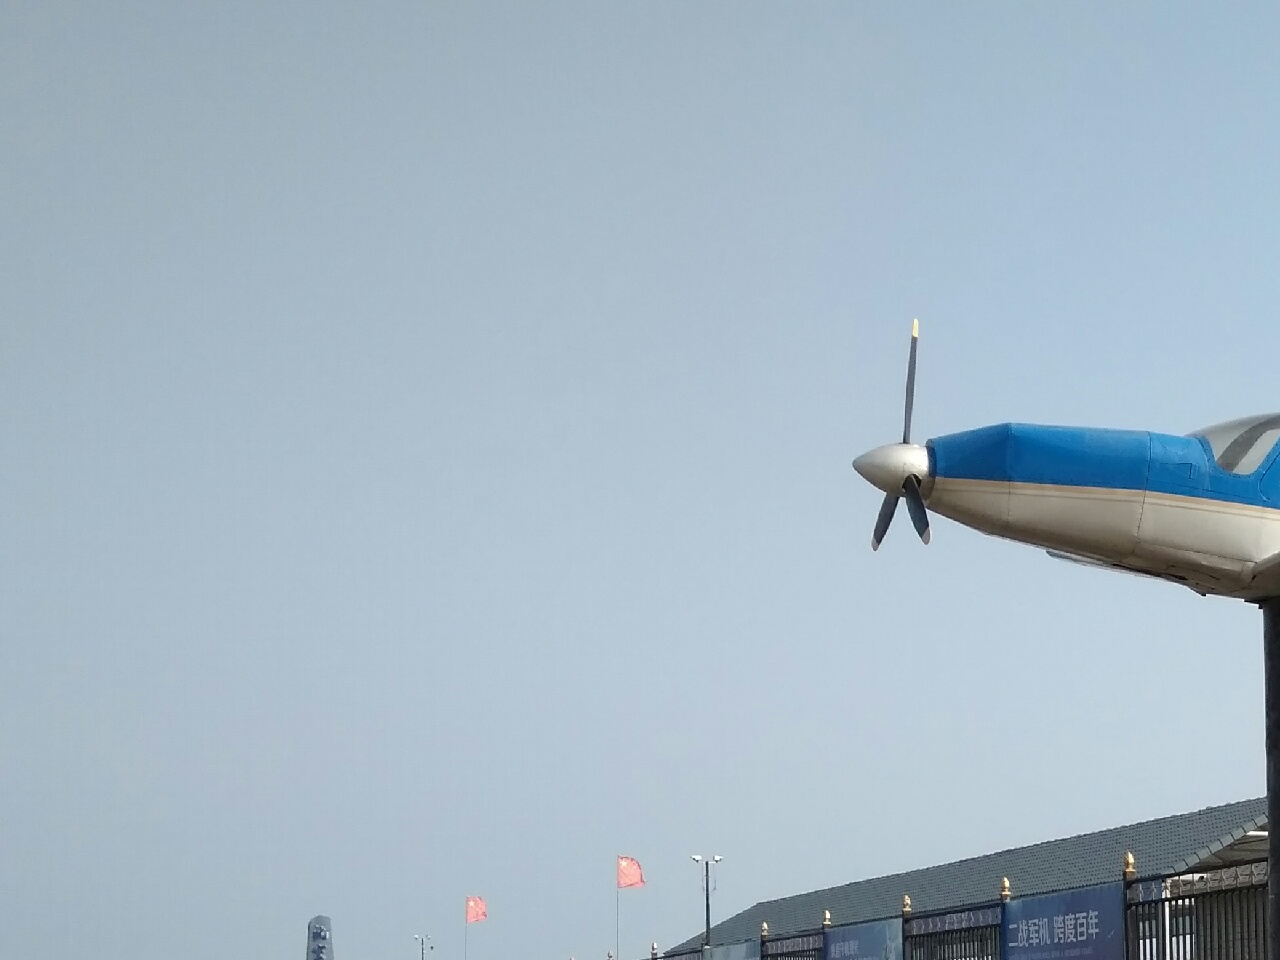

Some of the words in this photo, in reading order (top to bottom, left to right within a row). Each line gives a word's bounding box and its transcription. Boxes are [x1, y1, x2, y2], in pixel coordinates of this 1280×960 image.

[1008, 917, 1051, 947] 二战军机
[1053, 909, 1100, 944] 跨度百年
